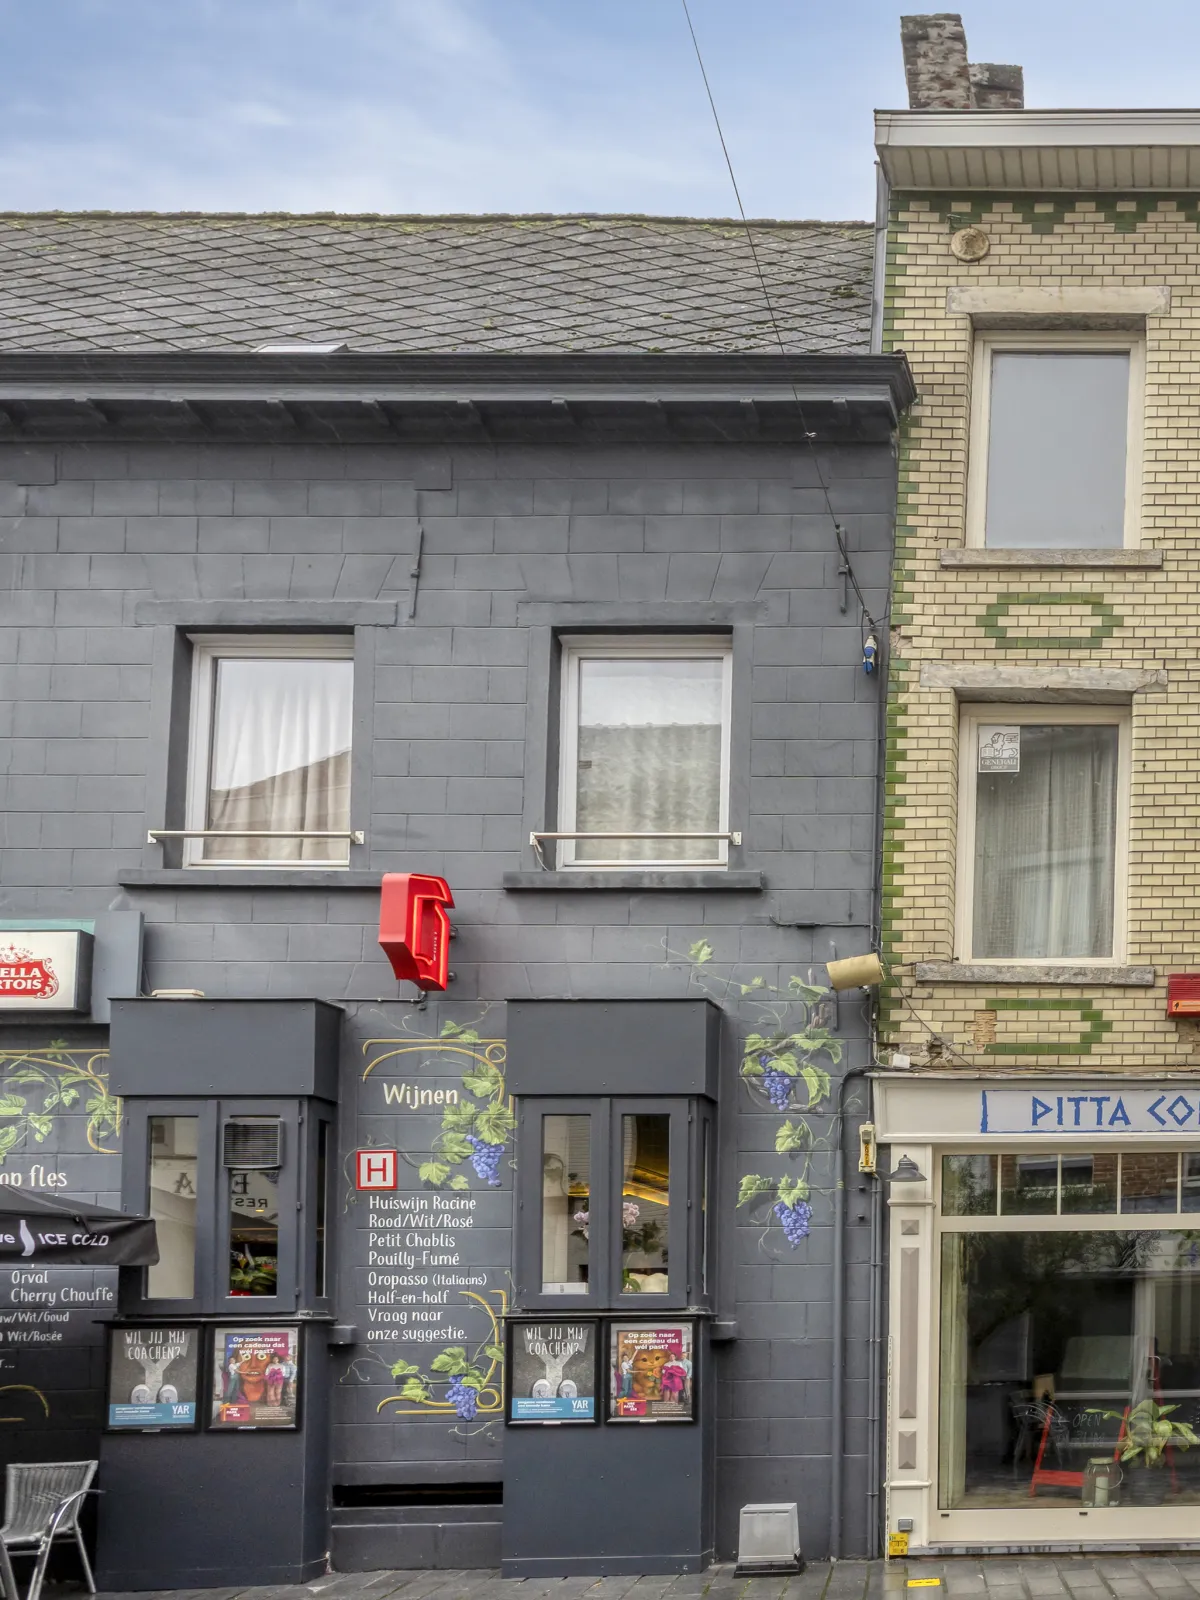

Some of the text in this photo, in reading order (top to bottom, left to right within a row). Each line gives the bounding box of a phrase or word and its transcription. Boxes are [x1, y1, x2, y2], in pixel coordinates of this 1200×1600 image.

[383, 1082, 459, 1110] Wijnen
[1031, 1095, 1132, 1126] PITTA
[28, 1164, 68, 1187] fles
[366, 1157, 387, 1183] H
[369, 1195, 477, 1212] Huiswijn Racine
[369, 1213, 474, 1228] Rood/Wit/Rosé
[37, 1233, 68, 1245] ICE
[368, 1232, 456, 1247] Petit Chablis
[368, 1250, 460, 1270] Pouilly-Fumé
[11, 1270, 49, 1284] Orval
[368, 1271, 487, 1289] Oropasso (Italiaans)
[10, 1287, 114, 1306] Cherry Chouffe
[368, 1290, 450, 1304] Half-en-half
[367, 1308, 444, 1325] Vraag naar
[125, 1331, 185, 1345] WIL JIJ MIJ
[367, 1326, 468, 1342] onze suggestie.
[526, 1327, 583, 1340] WIL JIJ MIJ
[128, 1346, 181, 1360] COACHEN?
[529, 1341, 580, 1355] COACHEN?
[172, 1405, 190, 1415] YAR
[571, 1400, 589, 1409] YAR
[1072, 1413, 1102, 1428] OPEN
